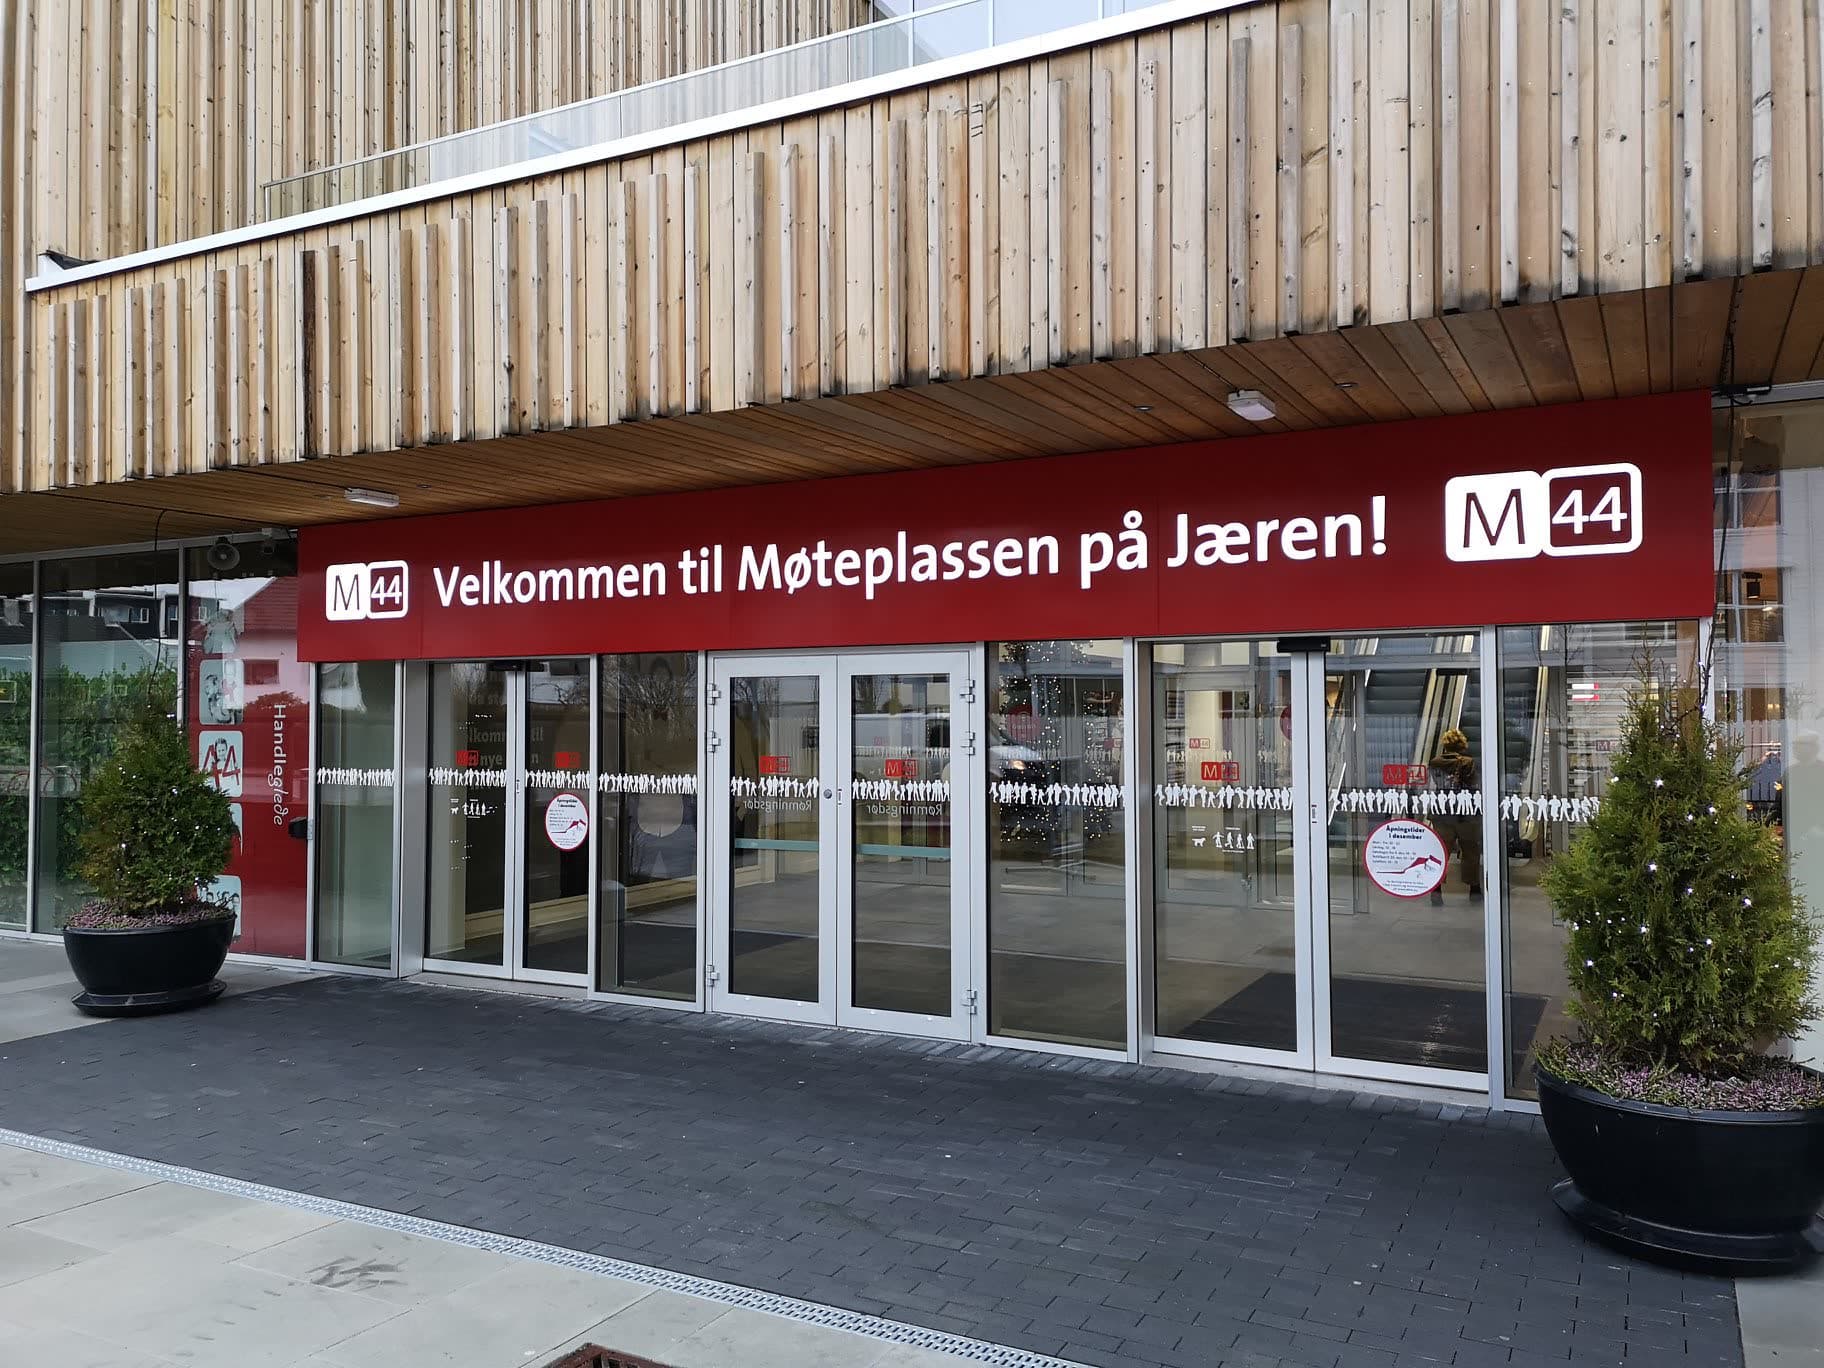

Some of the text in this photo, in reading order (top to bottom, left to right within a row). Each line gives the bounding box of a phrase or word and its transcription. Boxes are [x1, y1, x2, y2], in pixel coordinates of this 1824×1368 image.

[433, 495, 1388, 608] Velkommen til Møteplassen på Jæren!
